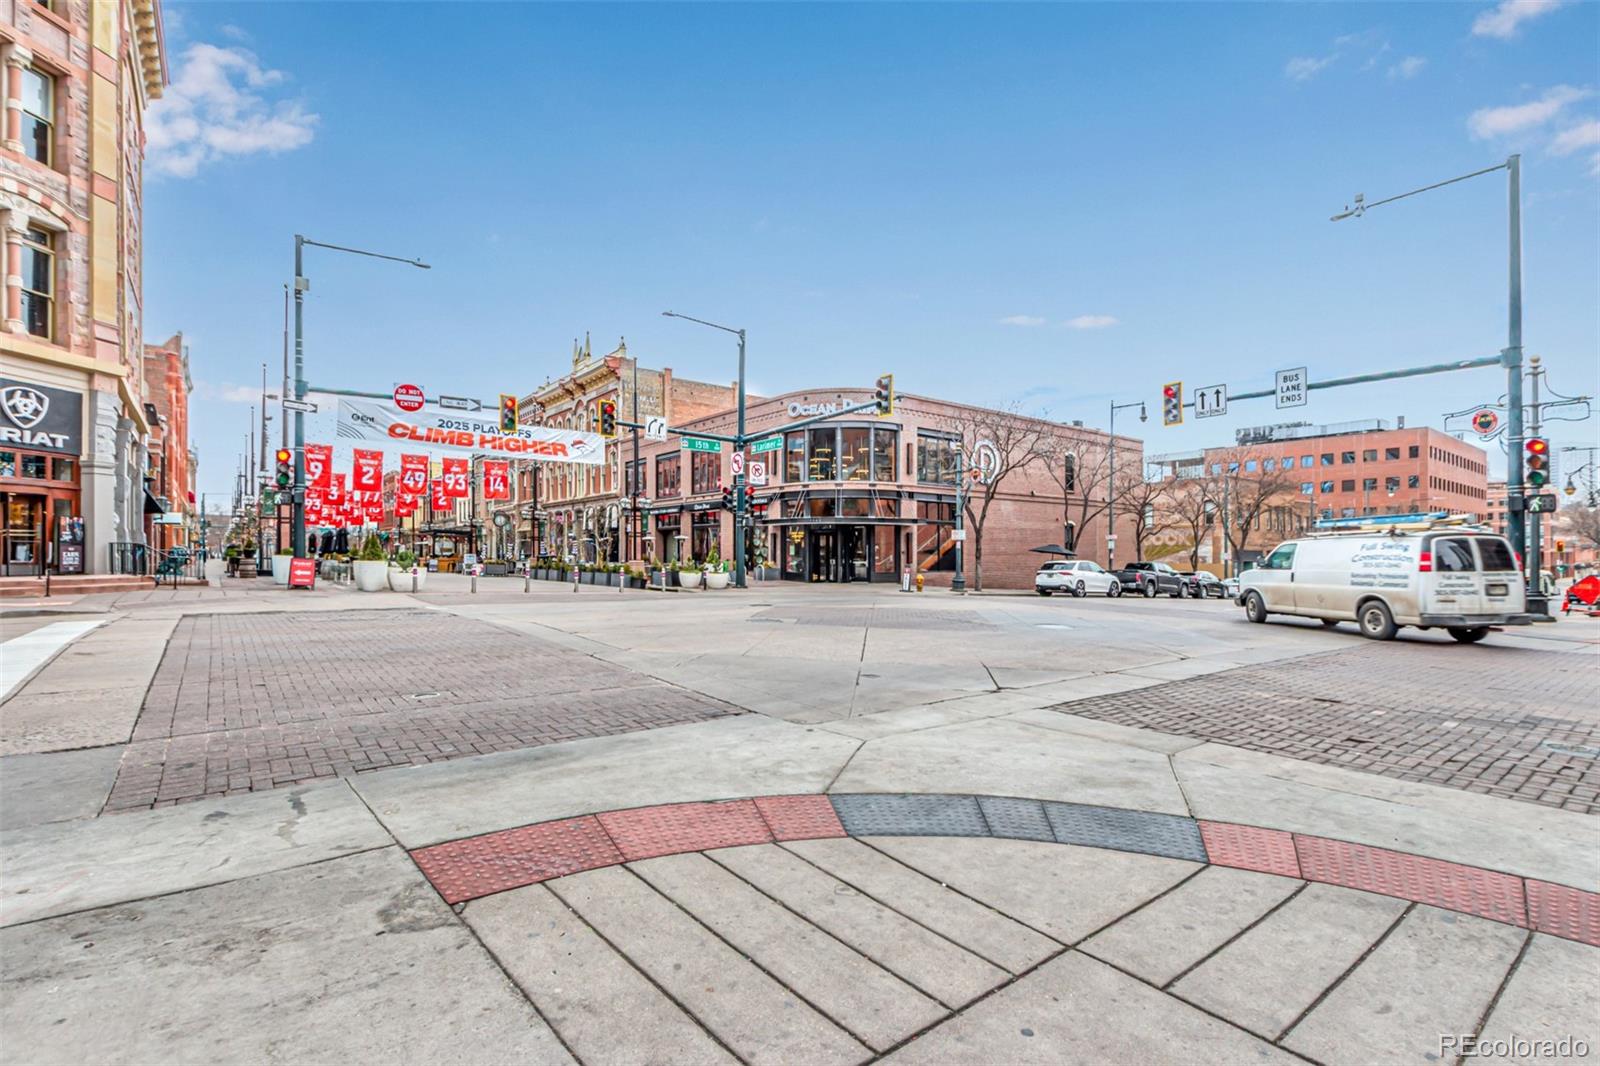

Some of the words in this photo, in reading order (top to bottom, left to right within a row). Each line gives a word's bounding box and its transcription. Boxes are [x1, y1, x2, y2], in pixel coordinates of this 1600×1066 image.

[1282, 374, 1300, 383] BUS
[1281, 383, 1301, 394] LANE
[1280, 393, 1302, 403] ENDS
[787, 402, 837, 418] OCEAN
[437, 418, 469, 431] 2025
[473, 423, 532, 438] PLAYOFFS
[0, 426, 70, 448] RIAT
[387, 422, 475, 447] CLIMB
[479, 433, 569, 457] HIGHER
[695, 440, 709, 449] 15th
[756, 440, 777, 451] Larimer
[309, 461, 323, 480] 9
[361, 466, 375, 485] 2
[403, 471, 425, 488] 49
[445, 474, 466, 490] 93
[489, 476, 504, 492] 14
